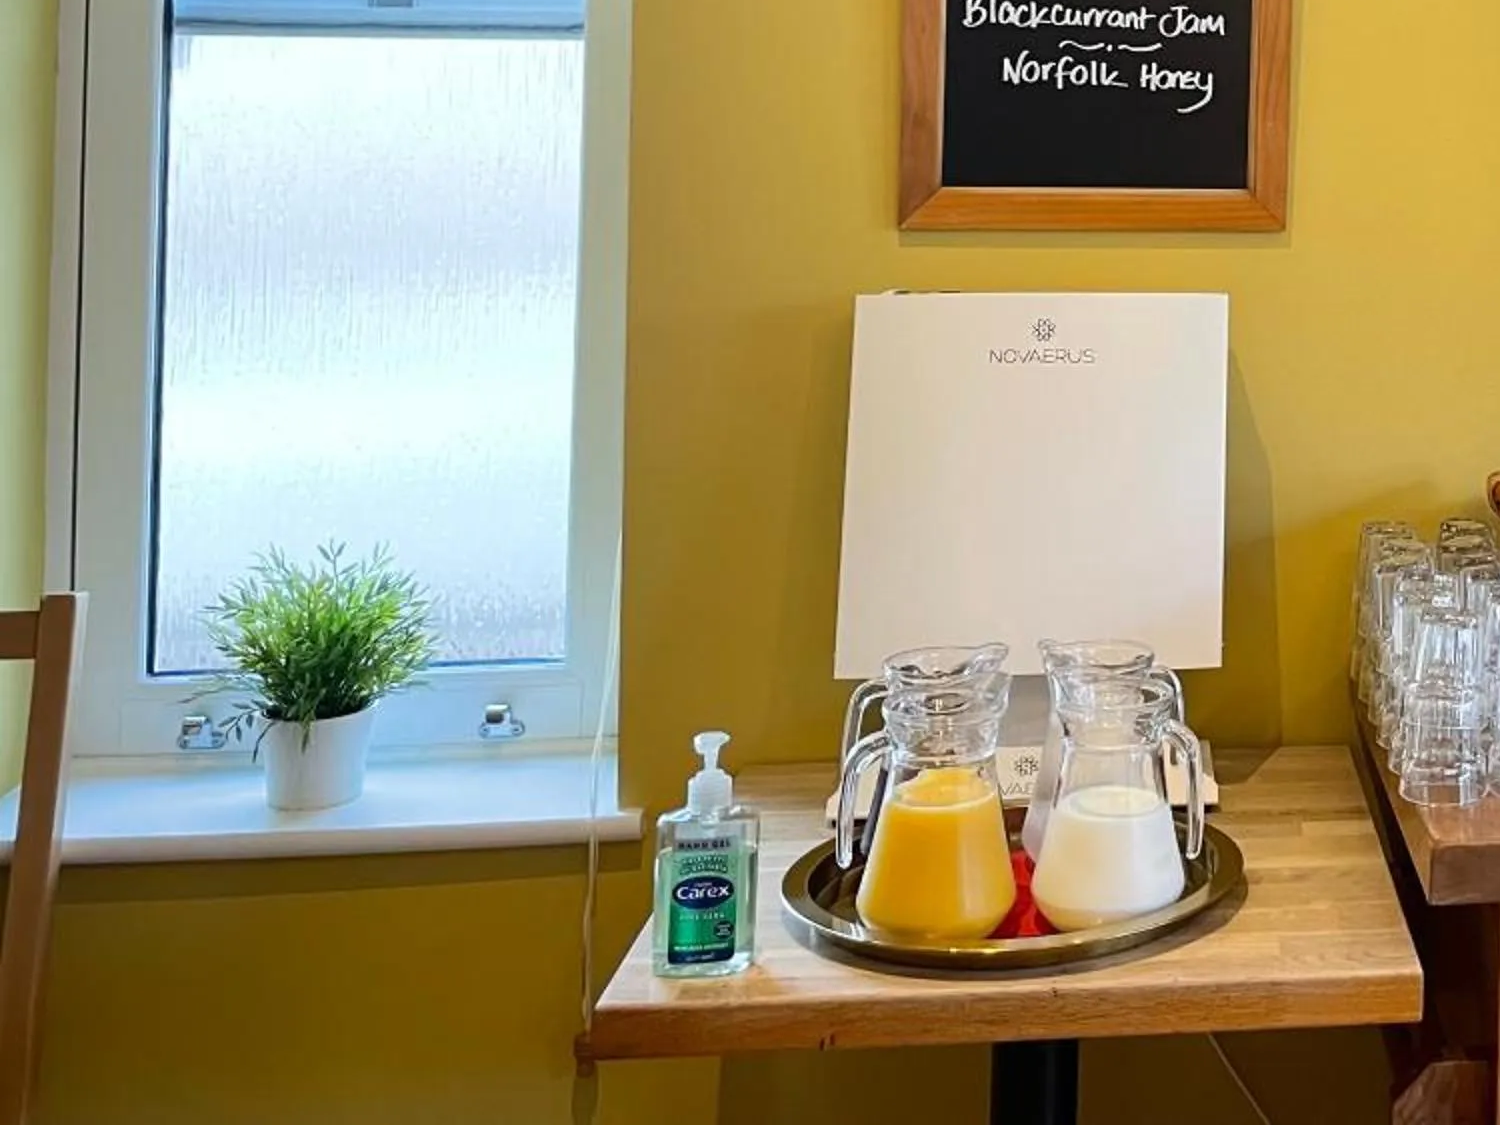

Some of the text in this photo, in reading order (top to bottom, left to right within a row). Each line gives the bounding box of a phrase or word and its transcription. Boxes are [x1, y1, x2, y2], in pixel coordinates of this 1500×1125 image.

[1158, 6, 1226, 37] Jam
[1002, 50, 1213, 113] Norfolk Honey
[989, 348, 1096, 364] NOVAERUS
[677, 885, 729, 900] Carex
